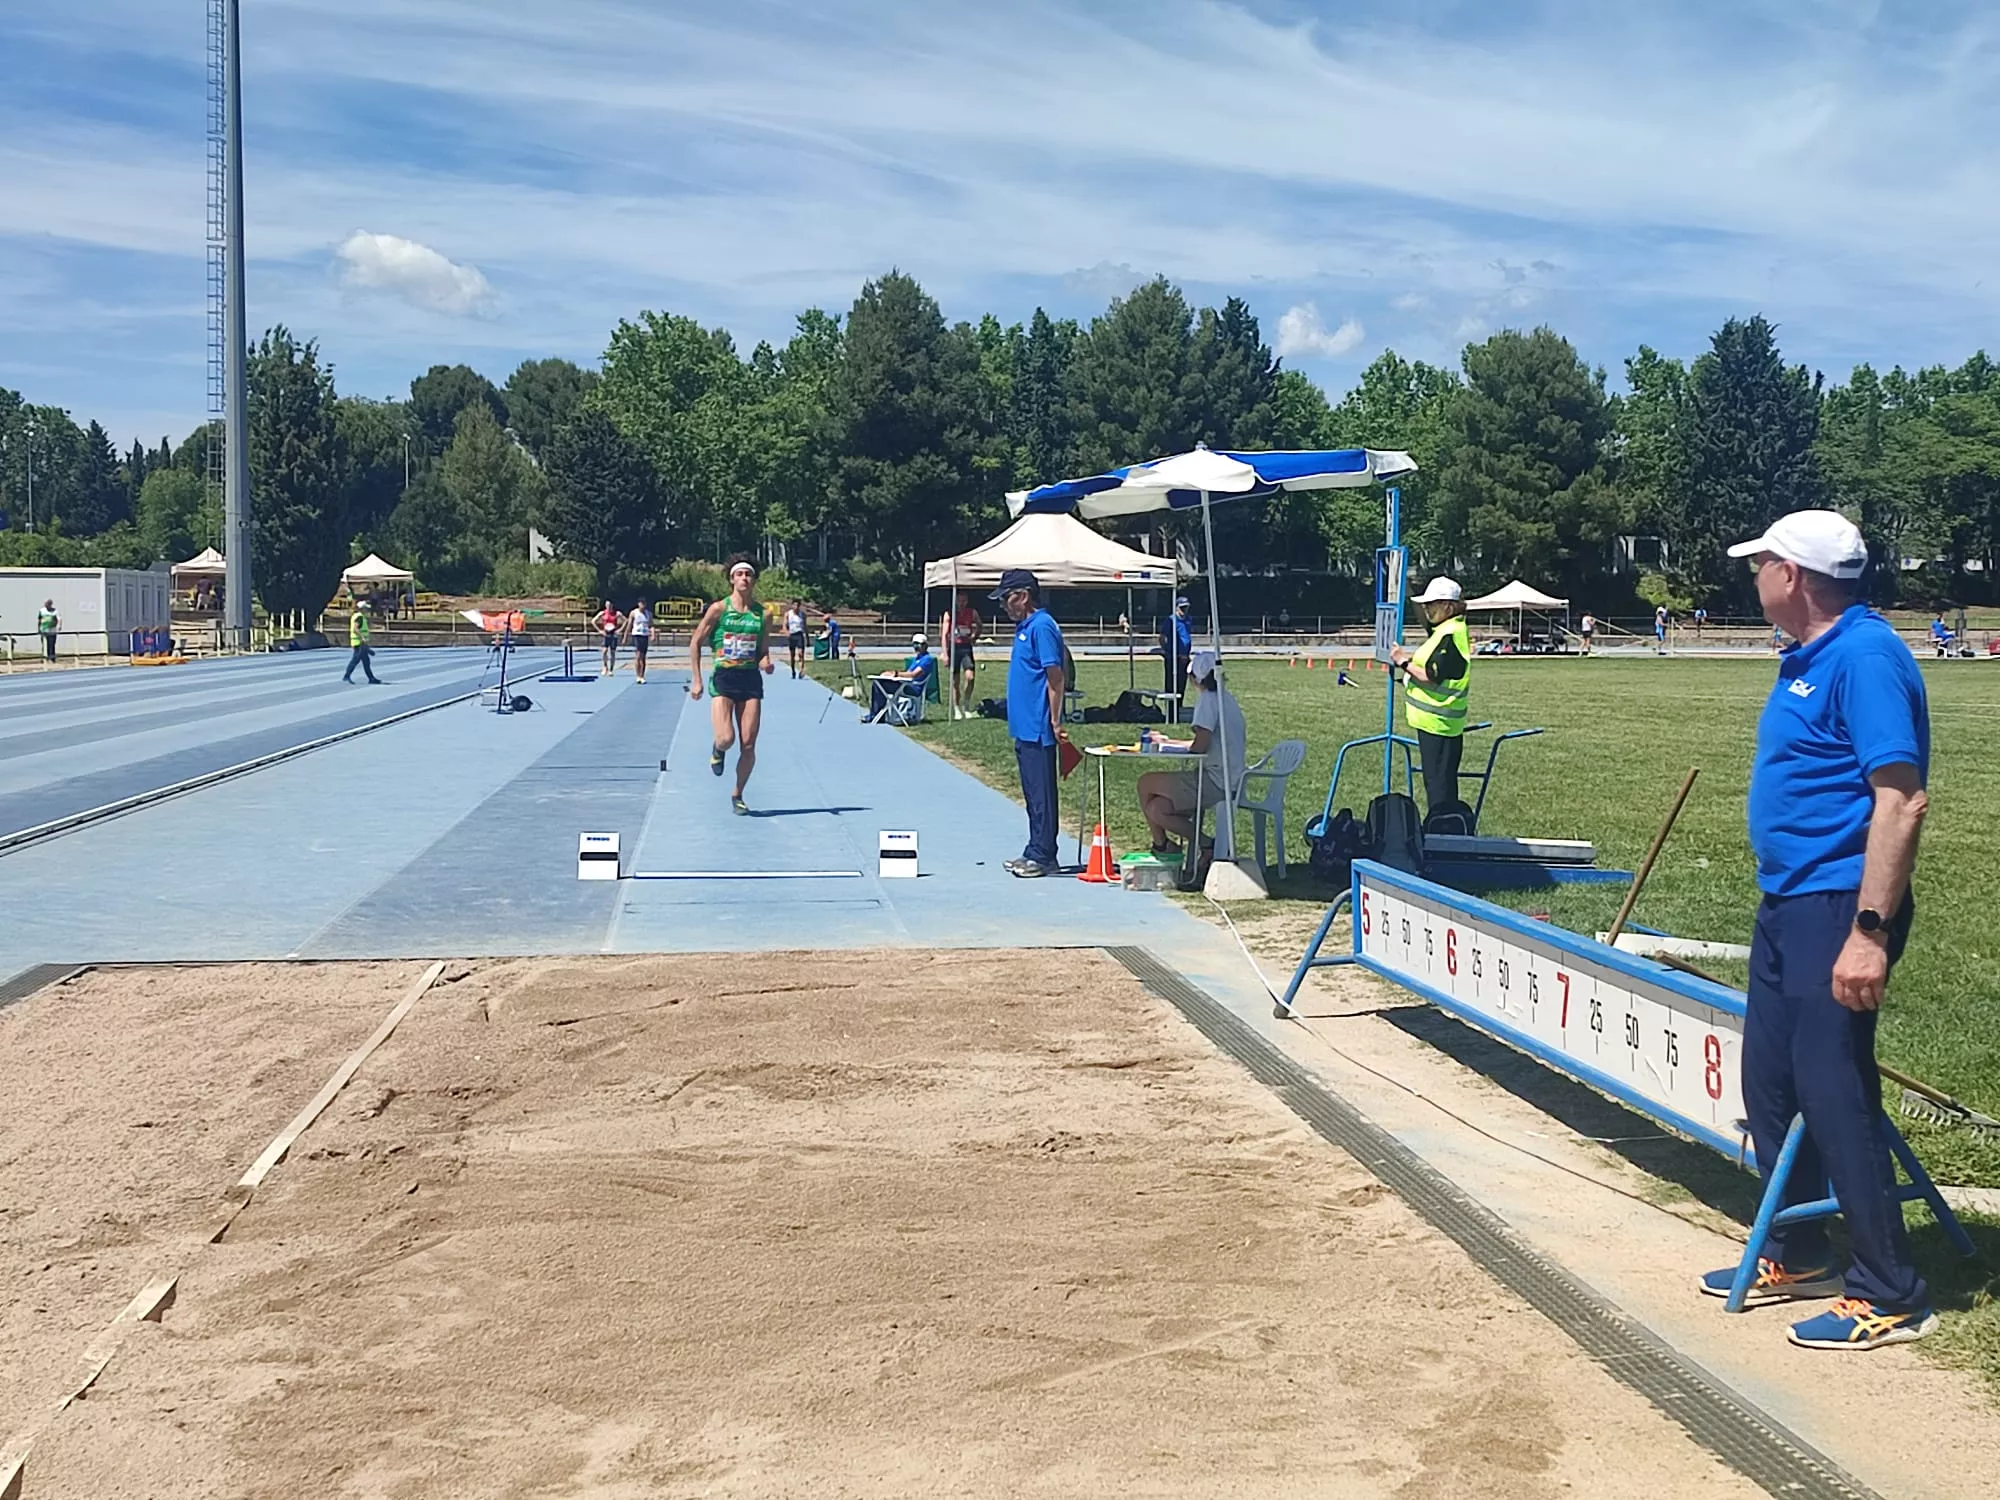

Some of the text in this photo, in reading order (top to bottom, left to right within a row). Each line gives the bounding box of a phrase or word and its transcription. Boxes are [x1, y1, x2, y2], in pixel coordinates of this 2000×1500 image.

[1362, 892, 1722, 1100] 5 25 50 75 6 25 50 75 7 25 50 75 8
